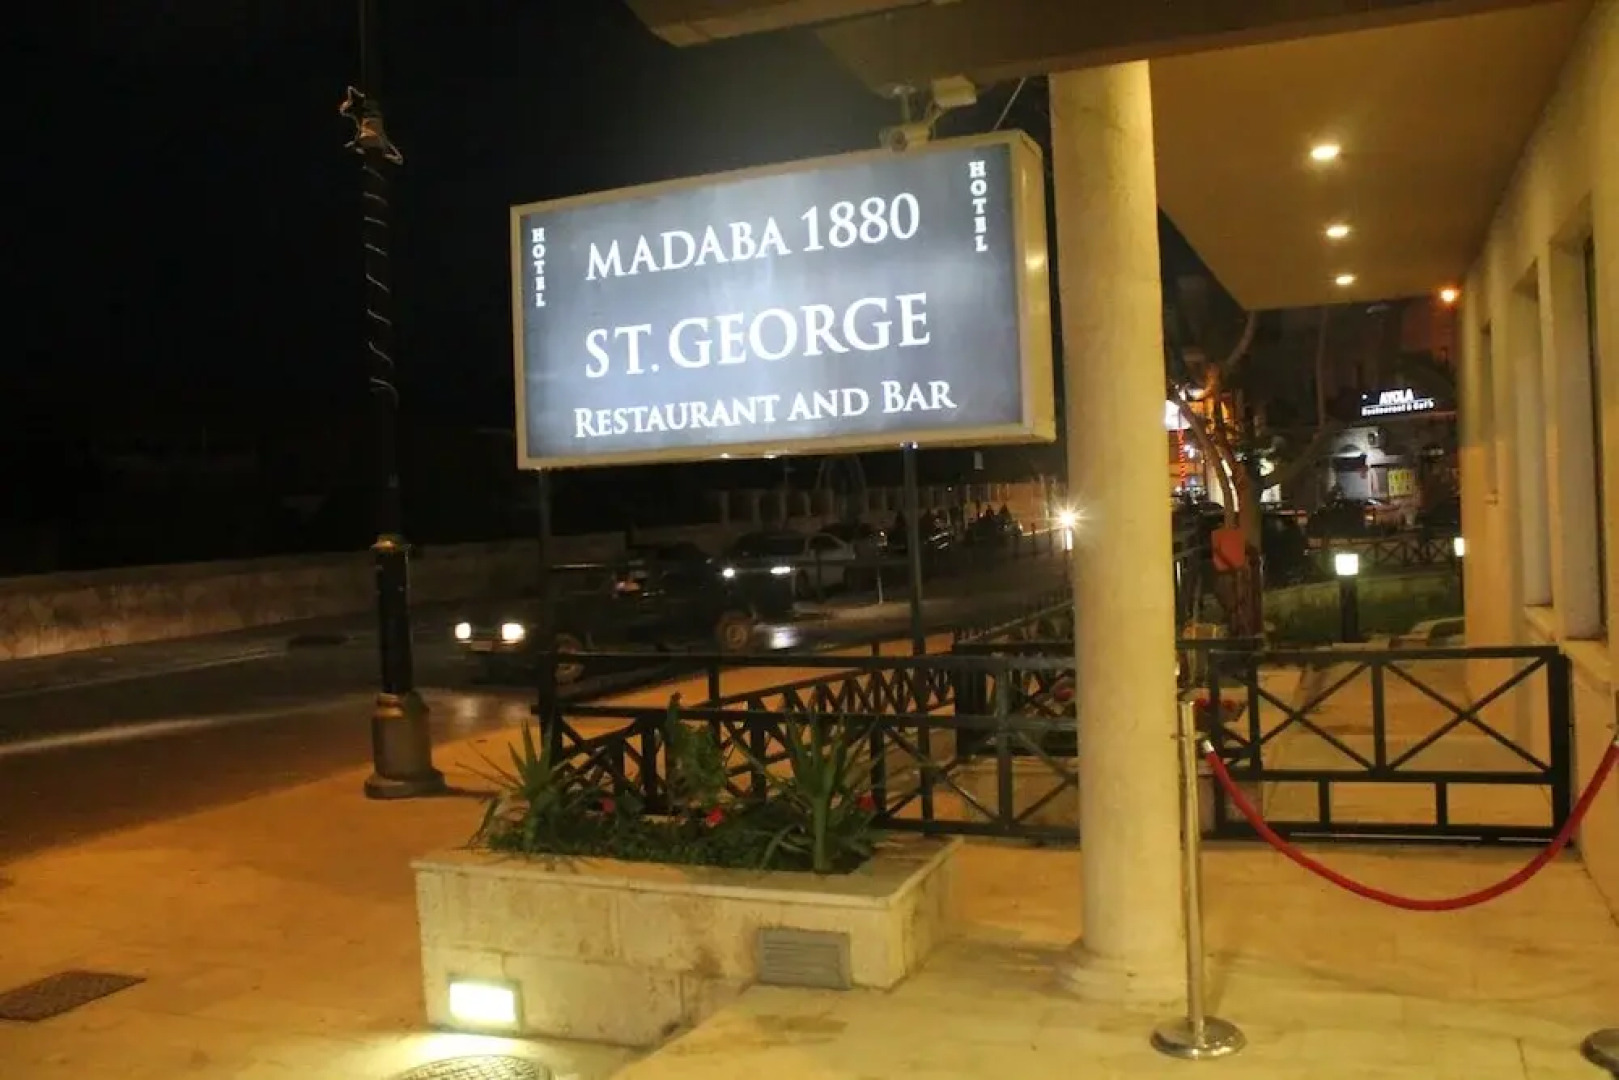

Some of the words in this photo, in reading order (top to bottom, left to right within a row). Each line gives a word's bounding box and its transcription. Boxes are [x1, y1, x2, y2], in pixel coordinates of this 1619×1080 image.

[585, 216, 794, 281] MADABA
[800, 191, 920, 252] 1880
[969, 161, 988, 253] HOTEL
[532, 228, 546, 308] HOTEL
[585, 323, 661, 379] ST.
[668, 292, 931, 369] GEORGE
[787, 387, 869, 422] AND
